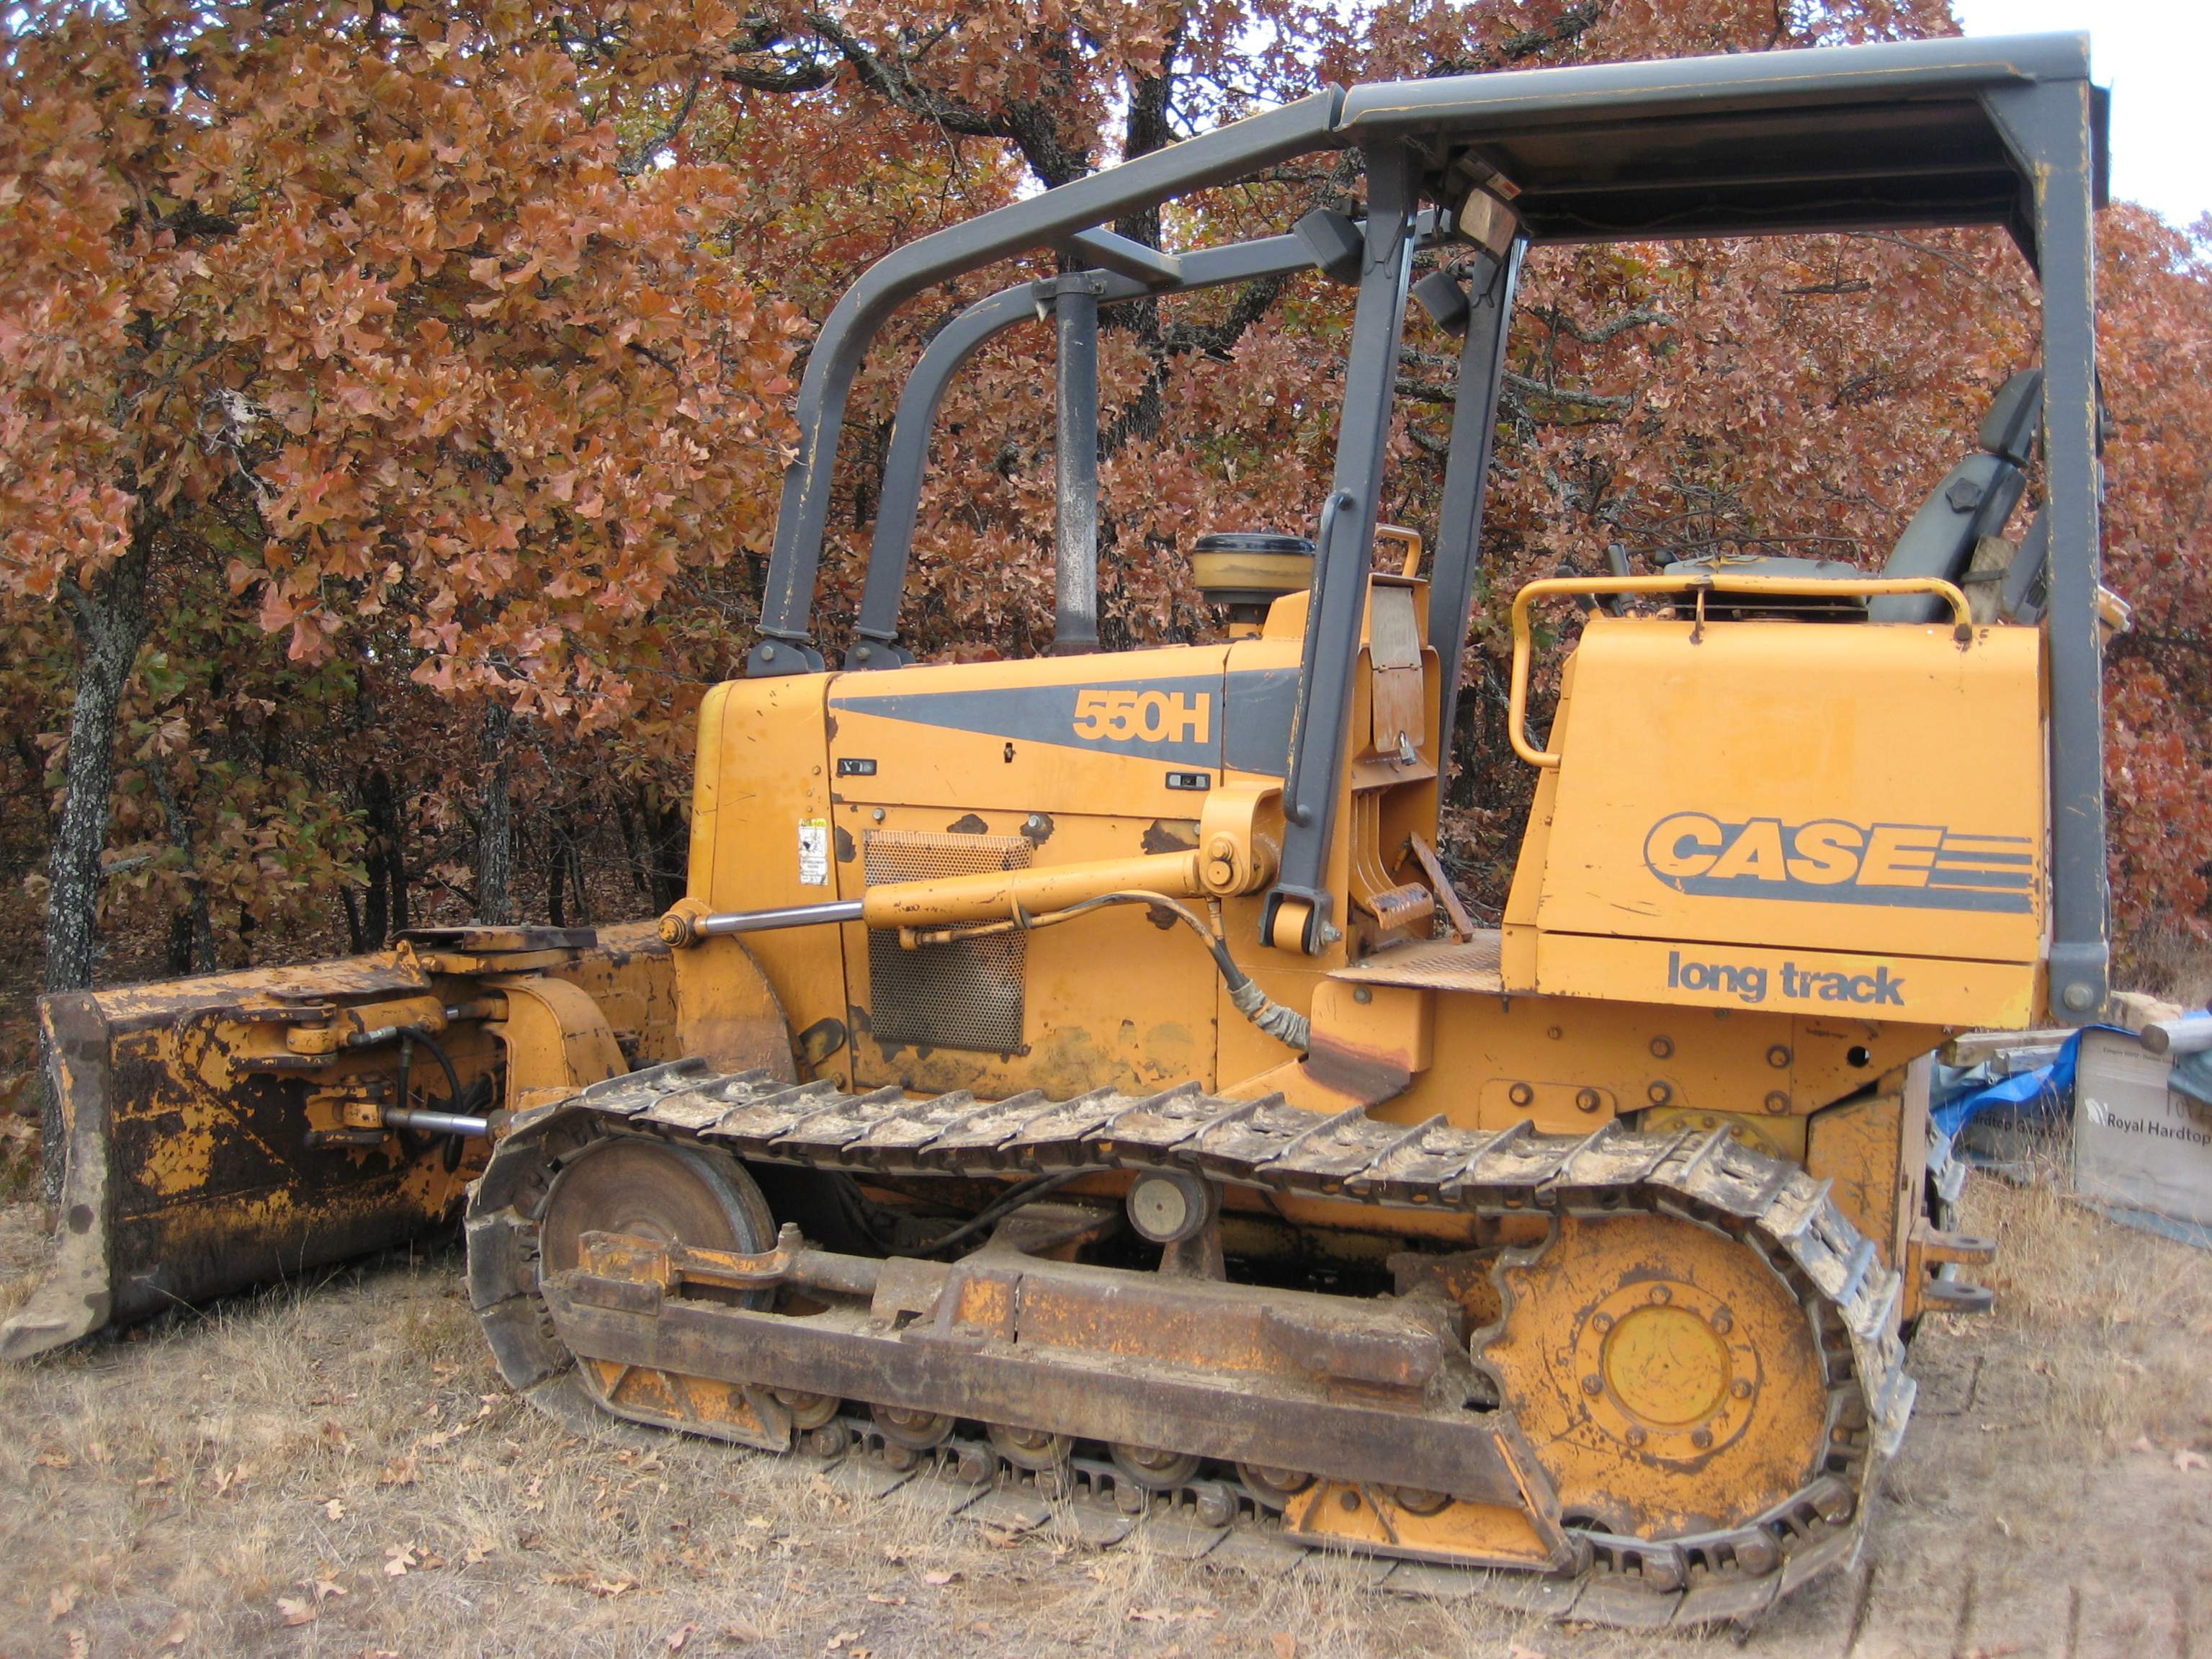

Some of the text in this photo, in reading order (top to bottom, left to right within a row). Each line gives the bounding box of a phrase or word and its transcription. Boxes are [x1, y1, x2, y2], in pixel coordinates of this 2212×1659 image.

[1073, 689, 1211, 743] 550H
[1644, 811, 1948, 888] CASE
[1667, 951, 1905, 1006] long track
[1970, 1114, 2012, 1132] ardtop
[2108, 1113, 2211, 1147] Royal Hardtop
